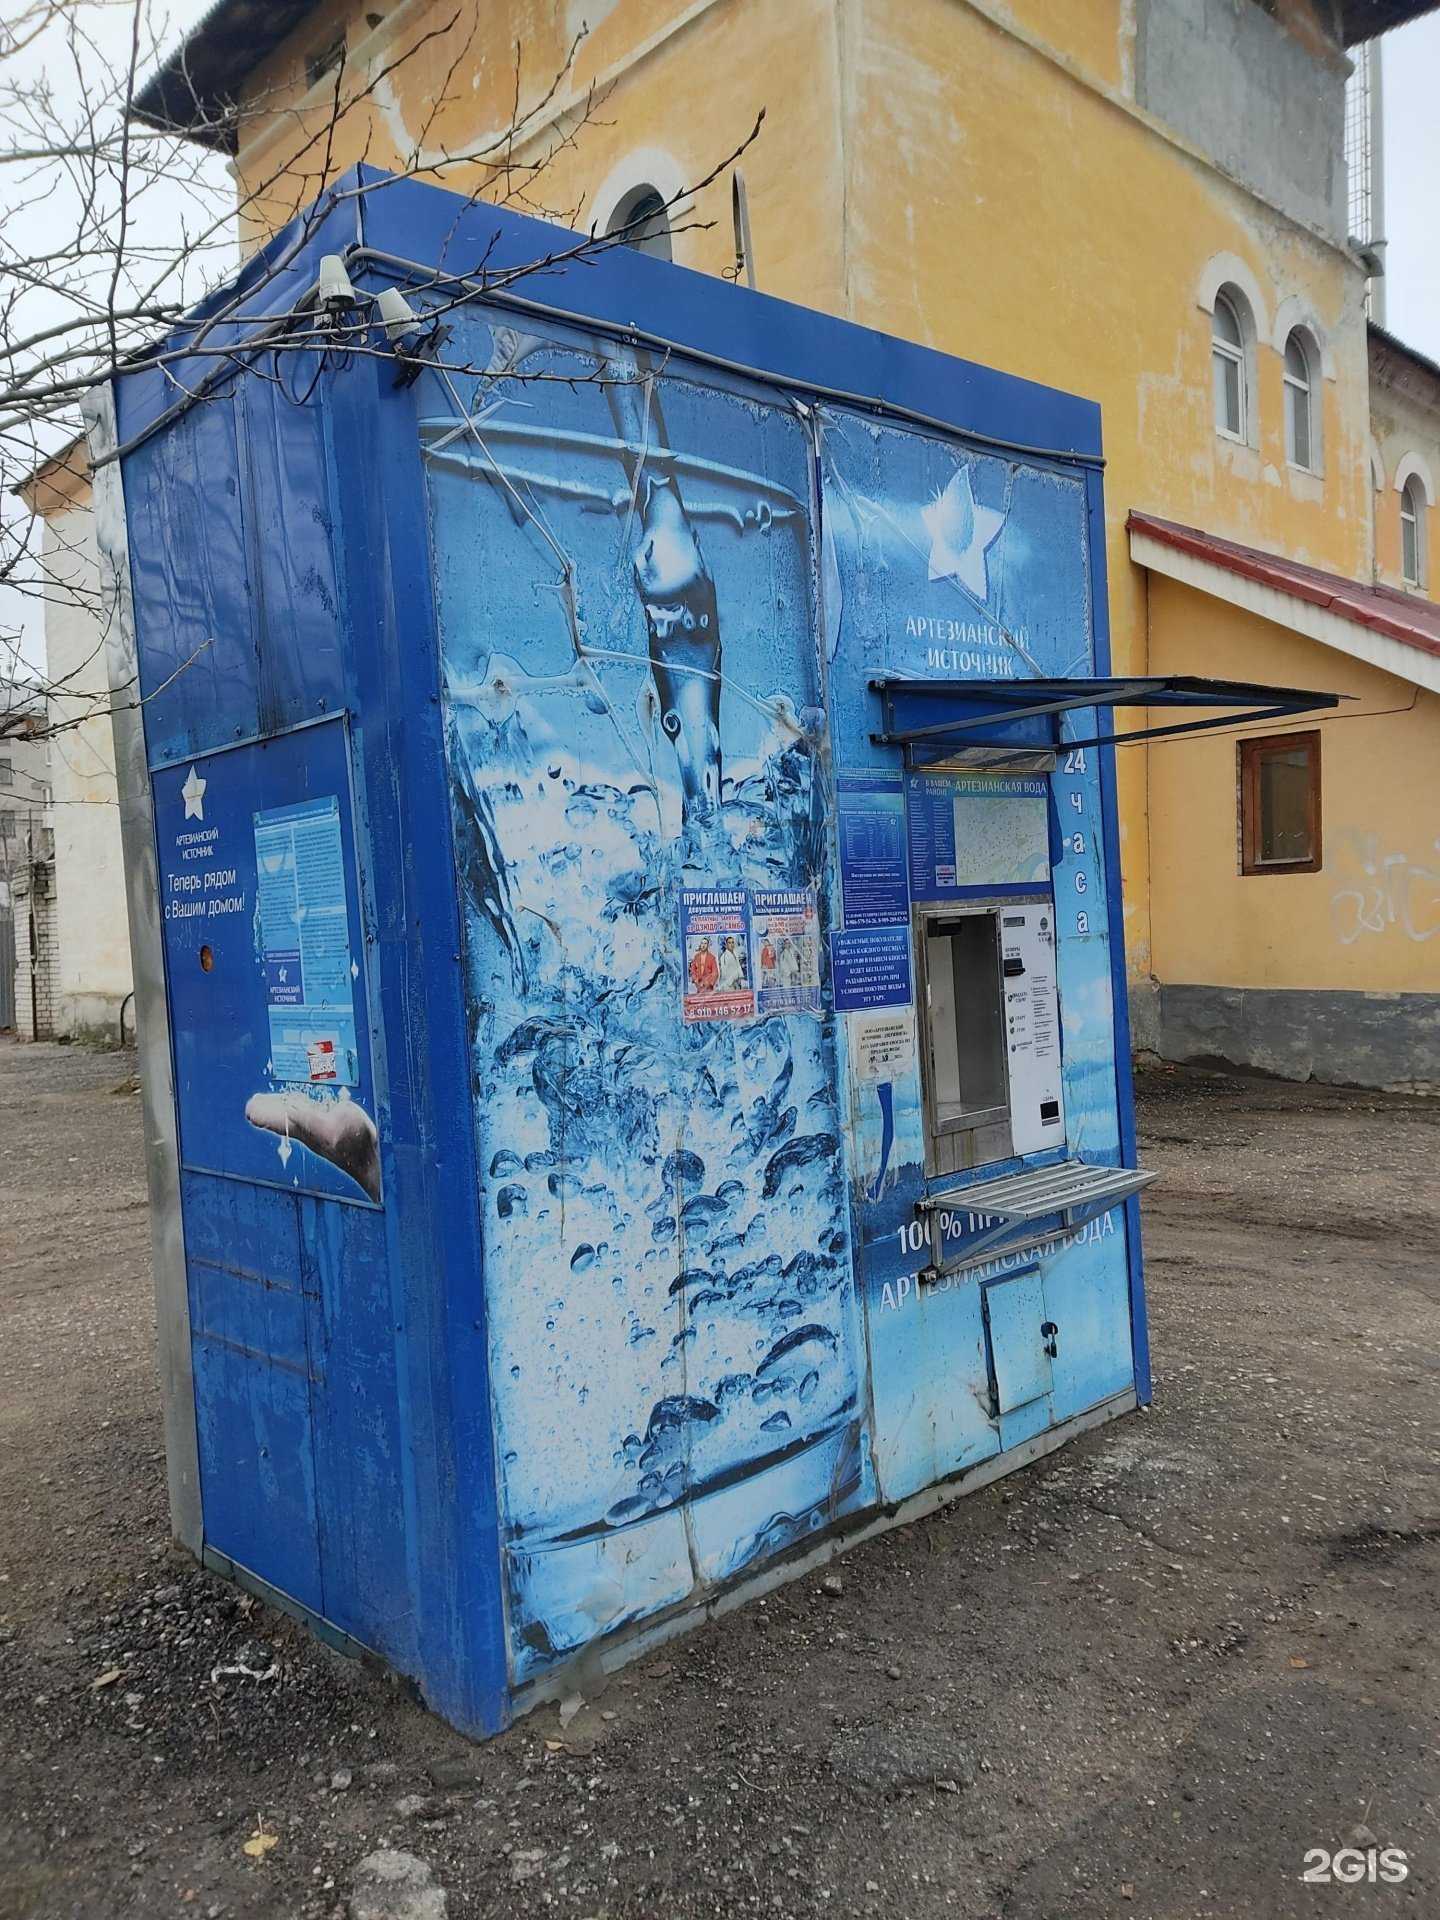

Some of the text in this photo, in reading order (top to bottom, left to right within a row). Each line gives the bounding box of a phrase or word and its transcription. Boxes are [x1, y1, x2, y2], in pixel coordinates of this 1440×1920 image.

[906, 615, 1030, 650] АРТЕЗИАНСКИЙ
[928, 647, 1013, 675] ИСТОЧНИК
[1064, 747, 1087, 774] 24
[955, 780, 1047, 794] АРТЕЗИАНСКАЯ ВОДА
[182, 845, 214, 860] ИСТОЧНИК
[168, 869, 236, 895] Теперь рядом
[165, 891, 245, 919] с Вашим домом!
[683, 891, 746, 905] ПРИГЛАШАЕМ
